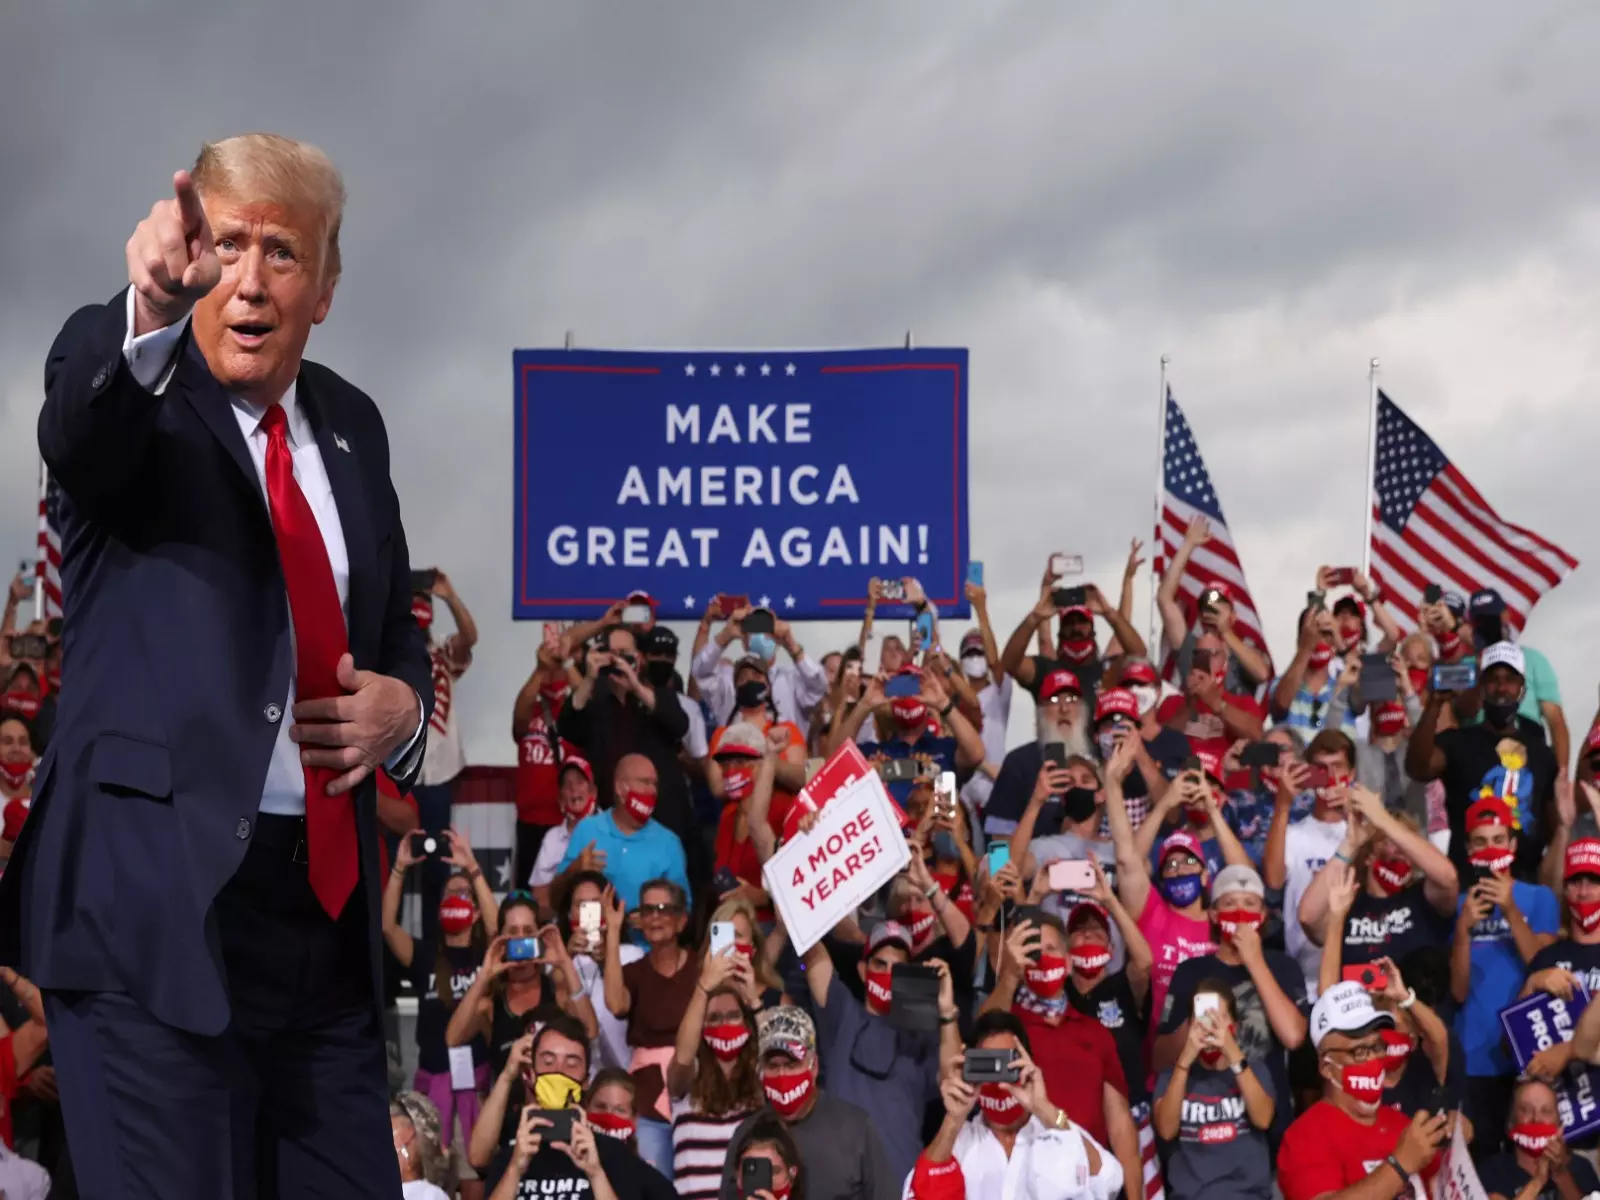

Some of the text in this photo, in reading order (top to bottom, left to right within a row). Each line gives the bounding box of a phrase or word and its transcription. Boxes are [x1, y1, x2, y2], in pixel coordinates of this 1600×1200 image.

[666, 403, 812, 444] MAKE
[617, 464, 860, 505] AMERICA
[547, 524, 930, 567] GREAT AGAIN!
[792, 808, 875, 887] 4 MORE
[801, 835, 884, 911] YEARS!
[1350, 907, 1411, 937] TRUMP
[1070, 953, 1110, 970] TRUMP
[1027, 967, 1065, 982] TRUMP
[868, 979, 892, 1001] TRU
[704, 1032, 749, 1052] TRUMP
[1347, 1069, 1386, 1090] TRU
[765, 1079, 810, 1105] TRUMP
[980, 1095, 1019, 1112] TRUM
[1181, 1097, 1245, 1123] TRUM
[1513, 1132, 1550, 1149] TRUM
[518, 1178, 590, 1194] RUMP
